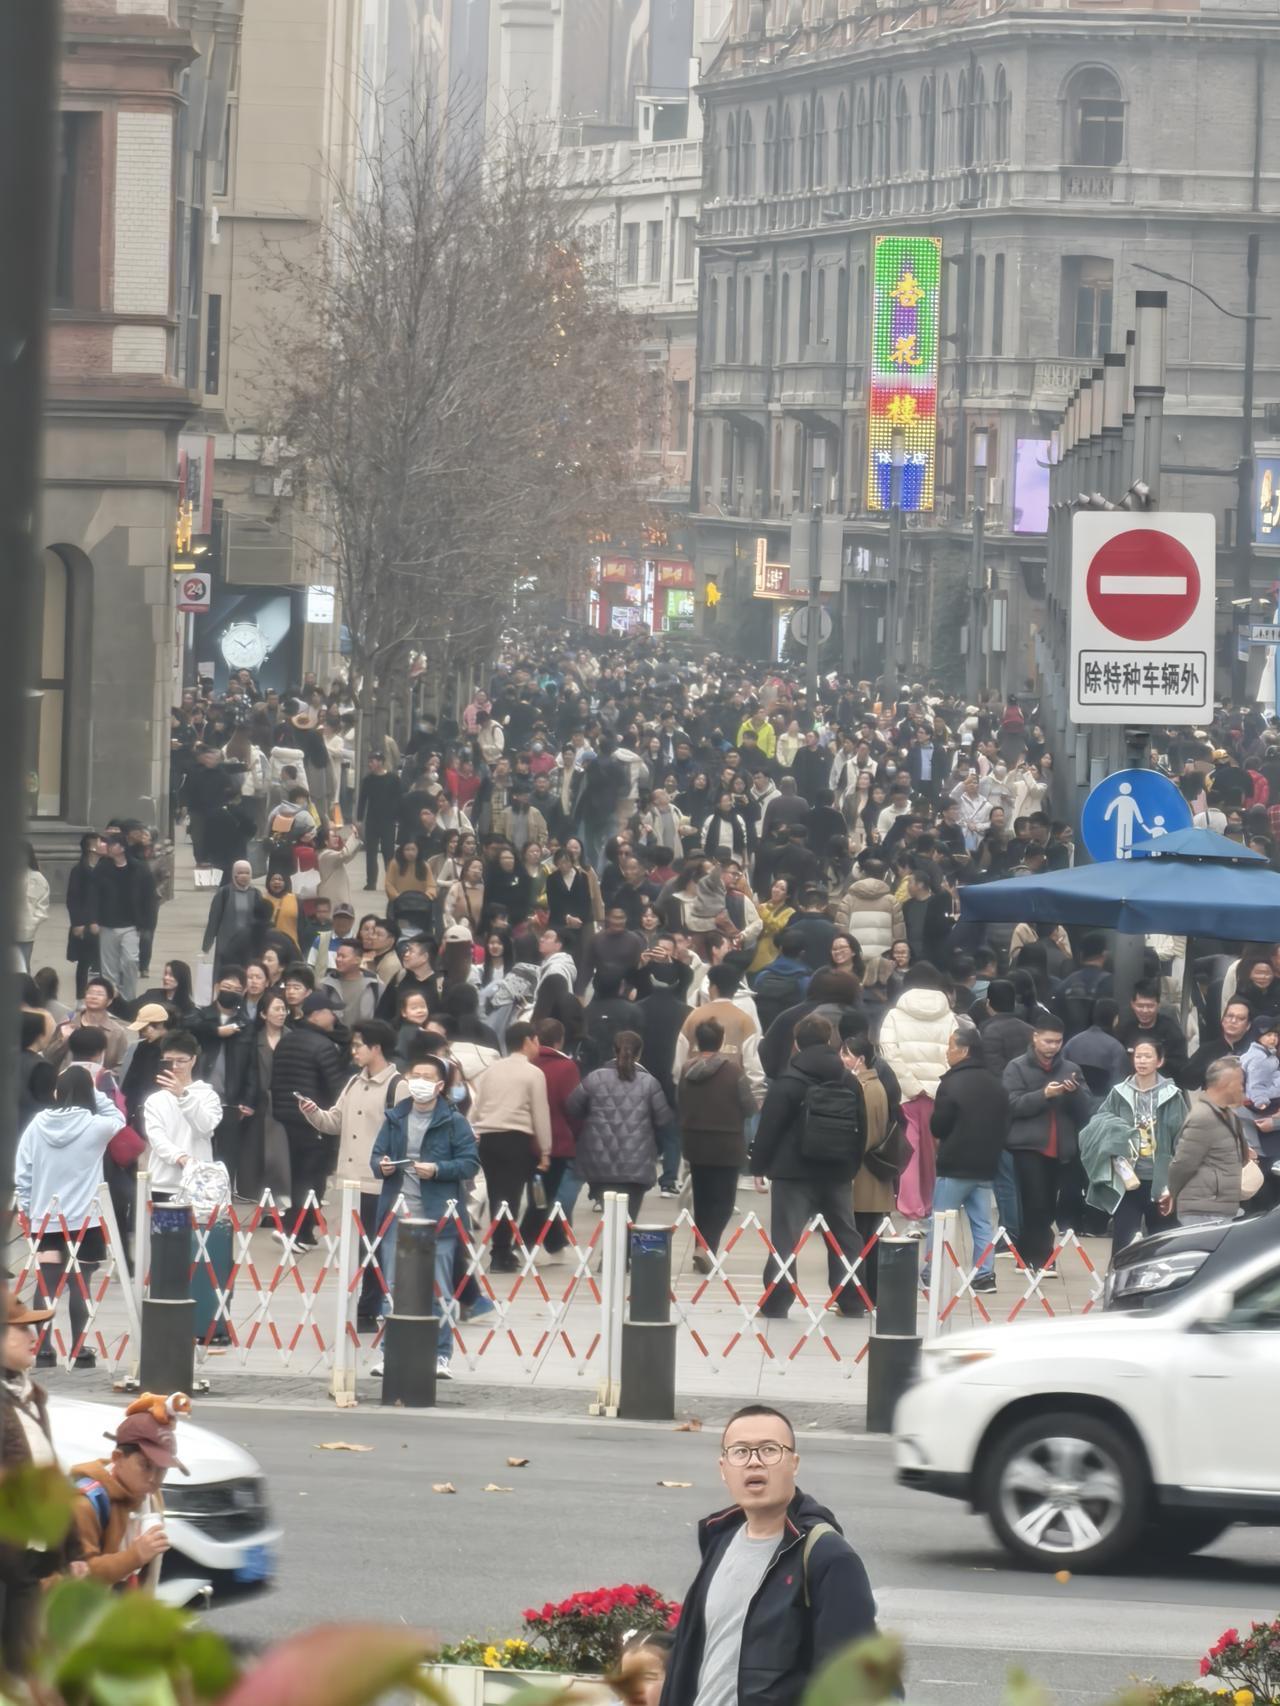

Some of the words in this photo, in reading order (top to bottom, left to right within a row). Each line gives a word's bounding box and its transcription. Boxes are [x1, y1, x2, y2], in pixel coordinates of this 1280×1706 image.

[186, 582, 204, 596] 24
[1084, 661, 1200, 696] 除特种车辆外
